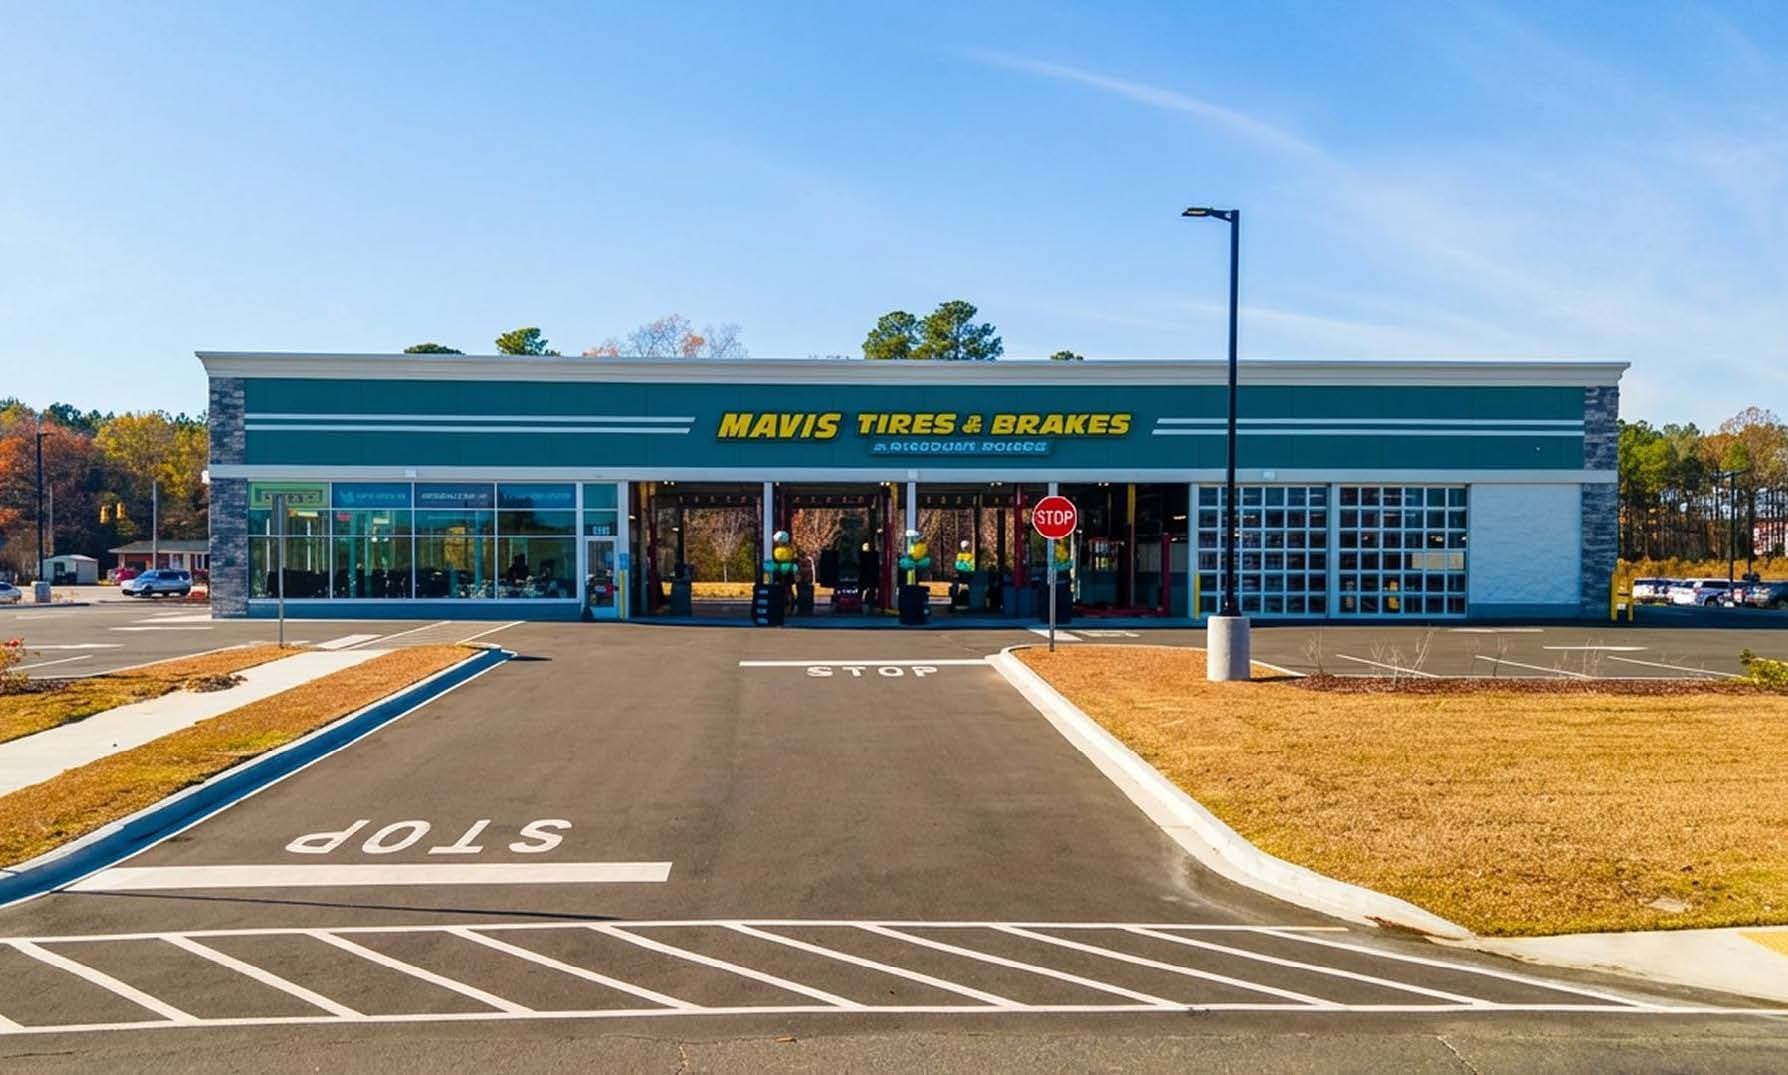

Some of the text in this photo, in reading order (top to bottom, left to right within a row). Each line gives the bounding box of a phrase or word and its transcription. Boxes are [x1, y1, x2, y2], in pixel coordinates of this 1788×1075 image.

[718, 413, 1132, 438] MAVIS TIRES & BRAKES
[1036, 509, 1074, 525] STOP
[807, 666, 938, 677] STOP
[285, 818, 572, 855] STOP
